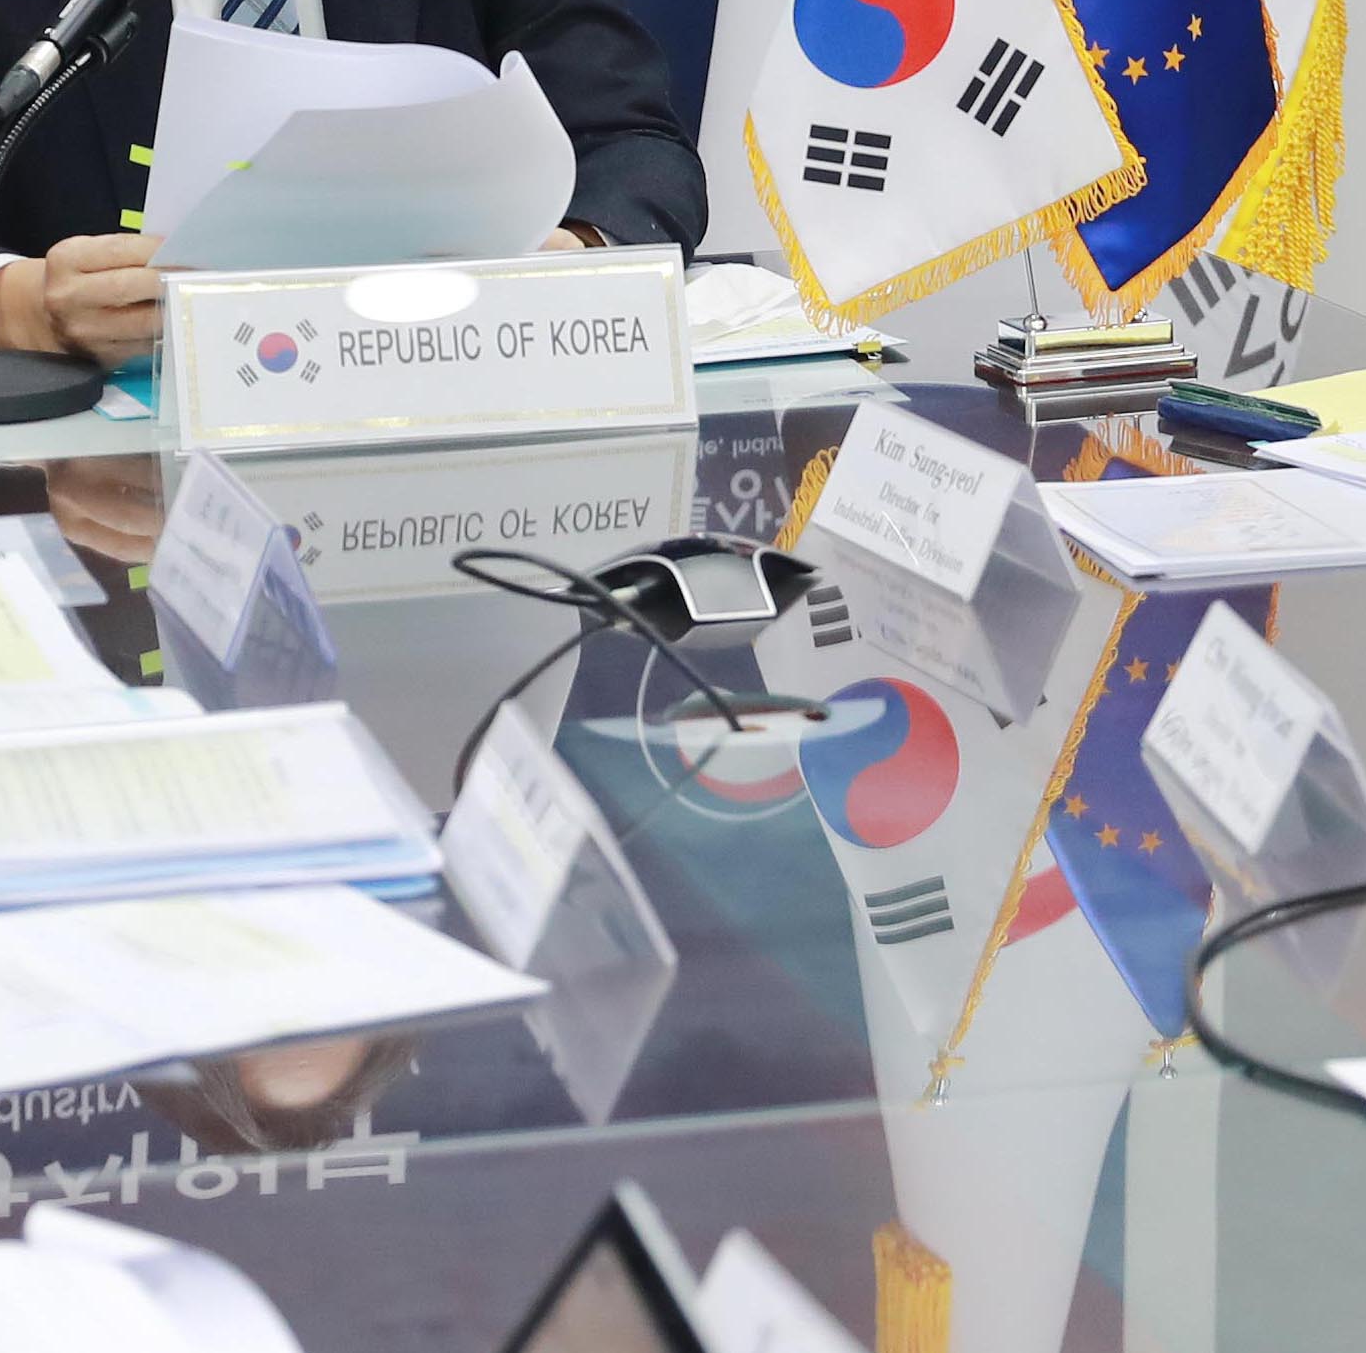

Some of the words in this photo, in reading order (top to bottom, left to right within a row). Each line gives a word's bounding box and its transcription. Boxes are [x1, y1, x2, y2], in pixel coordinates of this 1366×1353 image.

[338, 323, 482, 368] REPUBLIC
[497, 321, 535, 359] OF
[549, 316, 649, 356] KOREA
[874, 428, 906, 463] Kim
[908, 444, 984, 496] Sung-yeol
